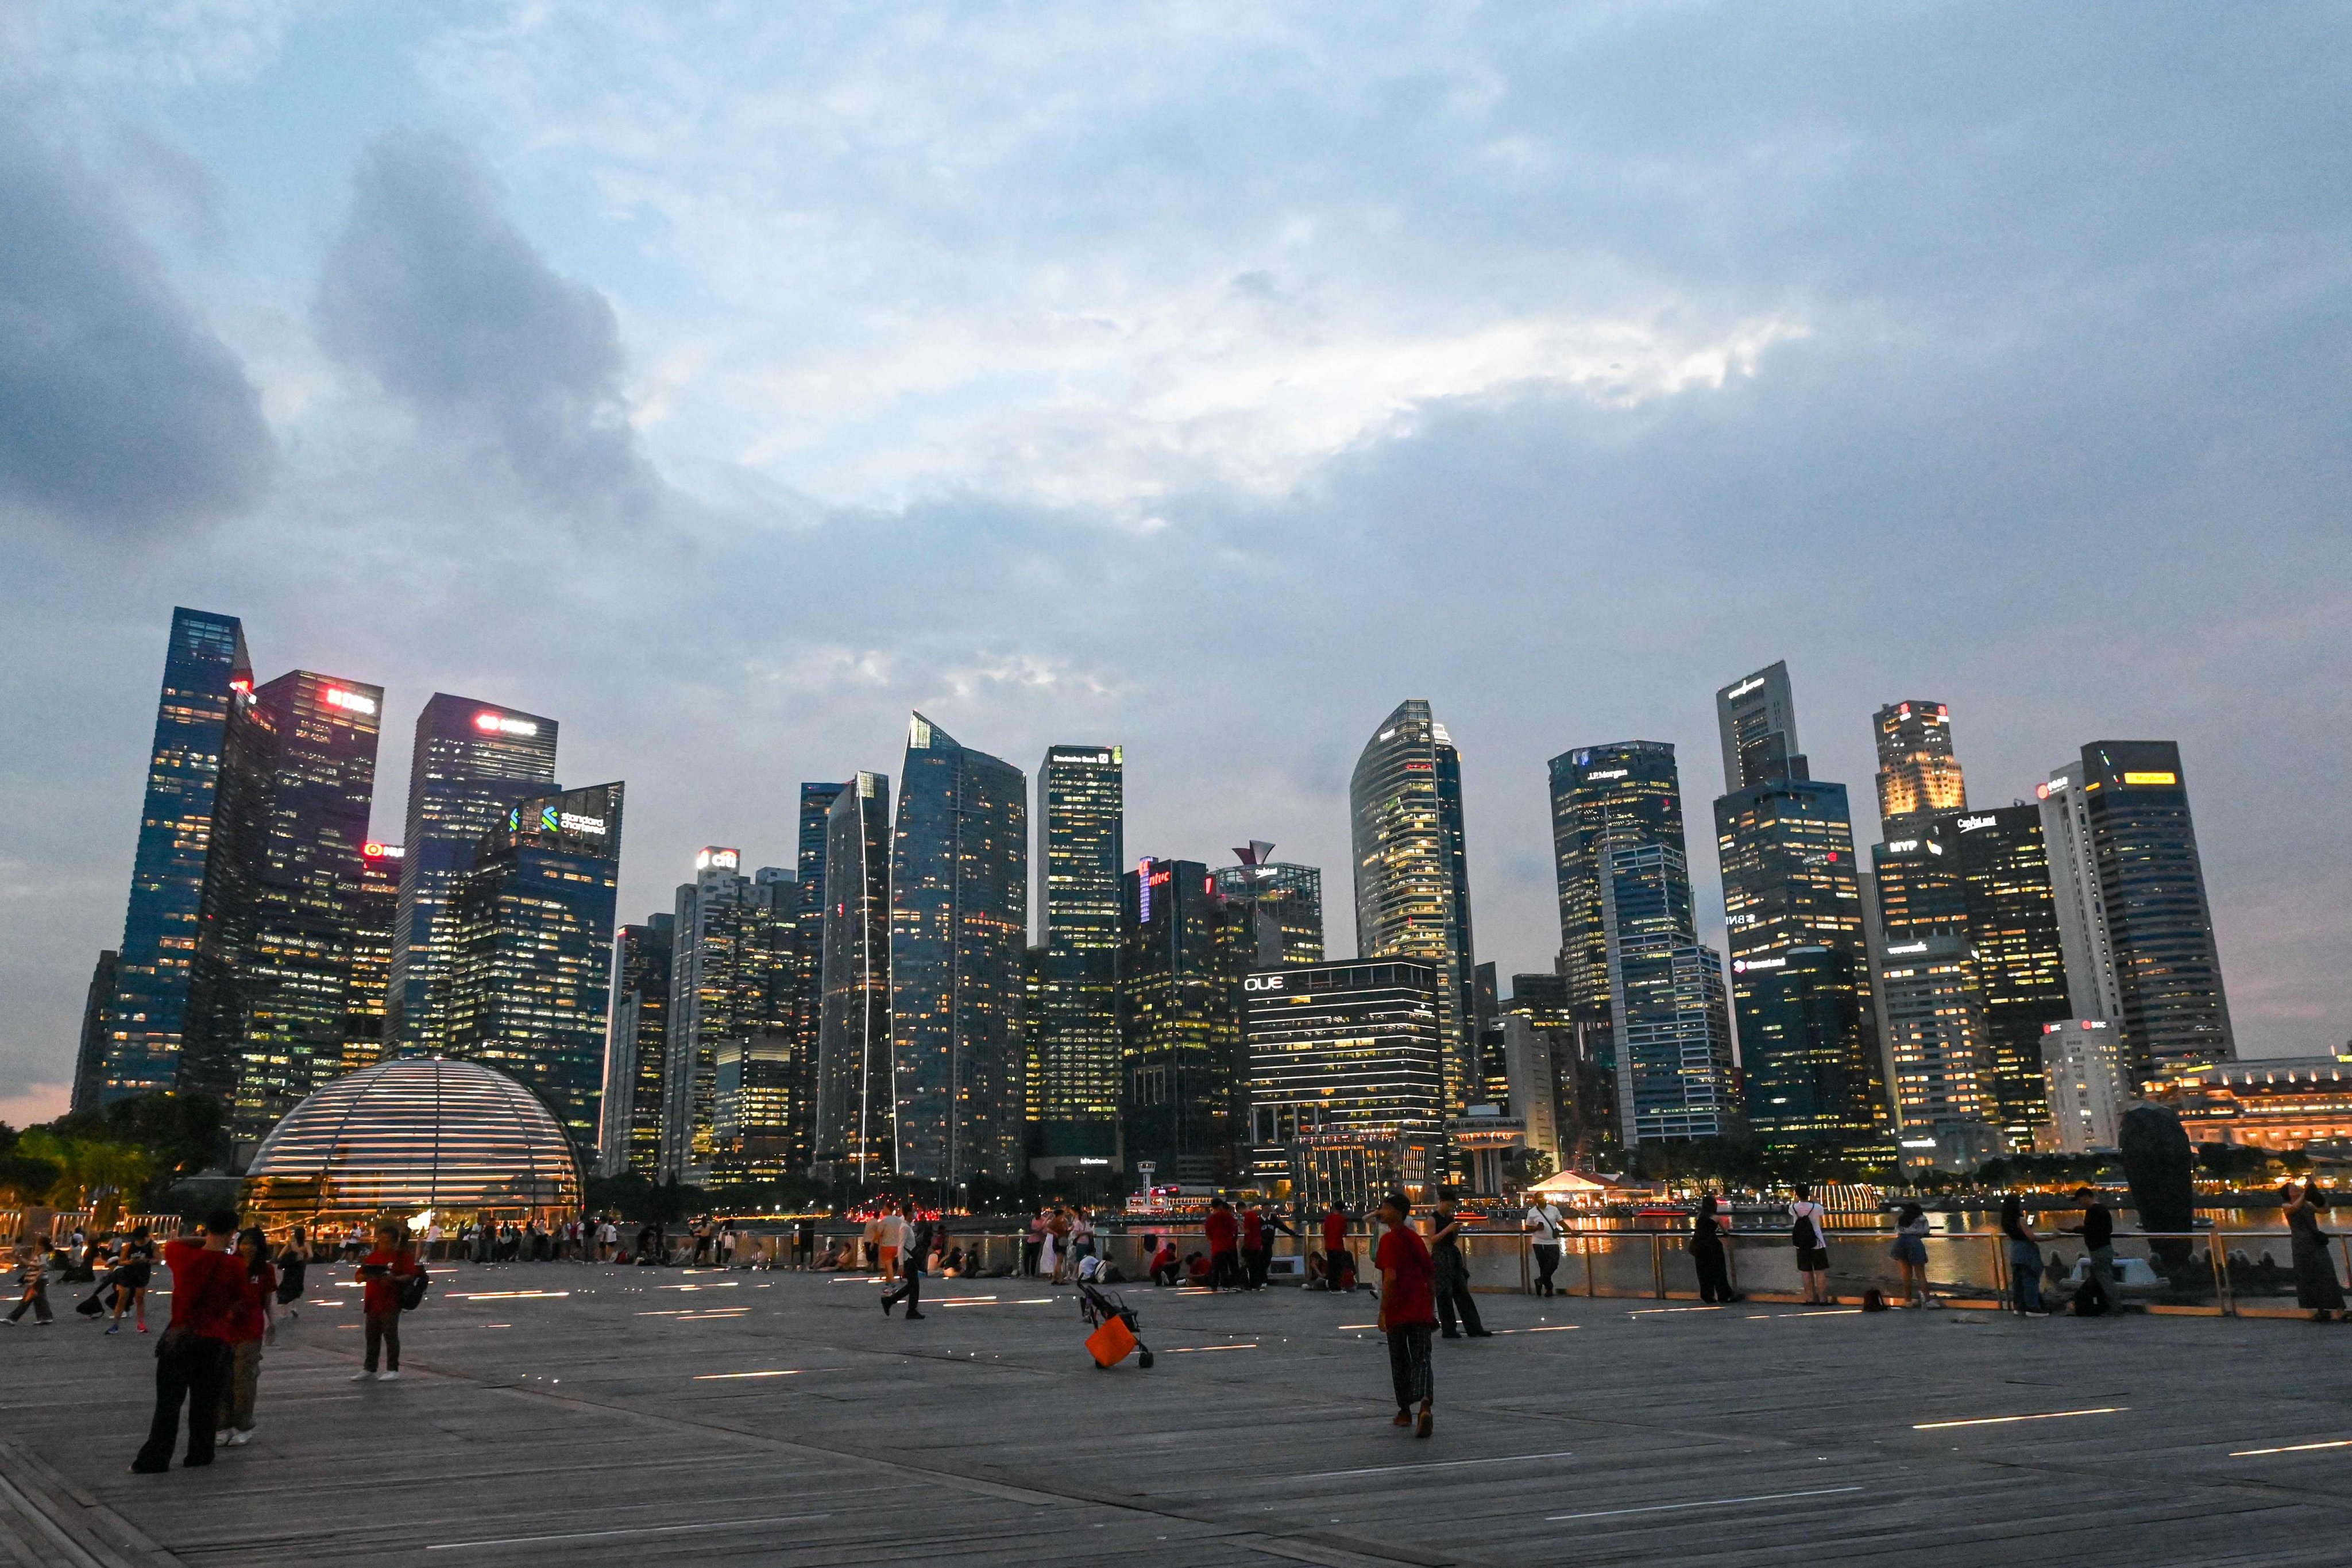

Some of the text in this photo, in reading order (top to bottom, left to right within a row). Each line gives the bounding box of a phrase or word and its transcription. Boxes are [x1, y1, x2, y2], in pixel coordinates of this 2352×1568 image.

[561, 812, 604, 827] standard
[1957, 816, 1996, 829] CapitaLand
[561, 820, 606, 835] chartered
[712, 853, 737, 868] citi
[1149, 871, 1170, 886] ntuc
[1244, 976, 1284, 991] OUE
